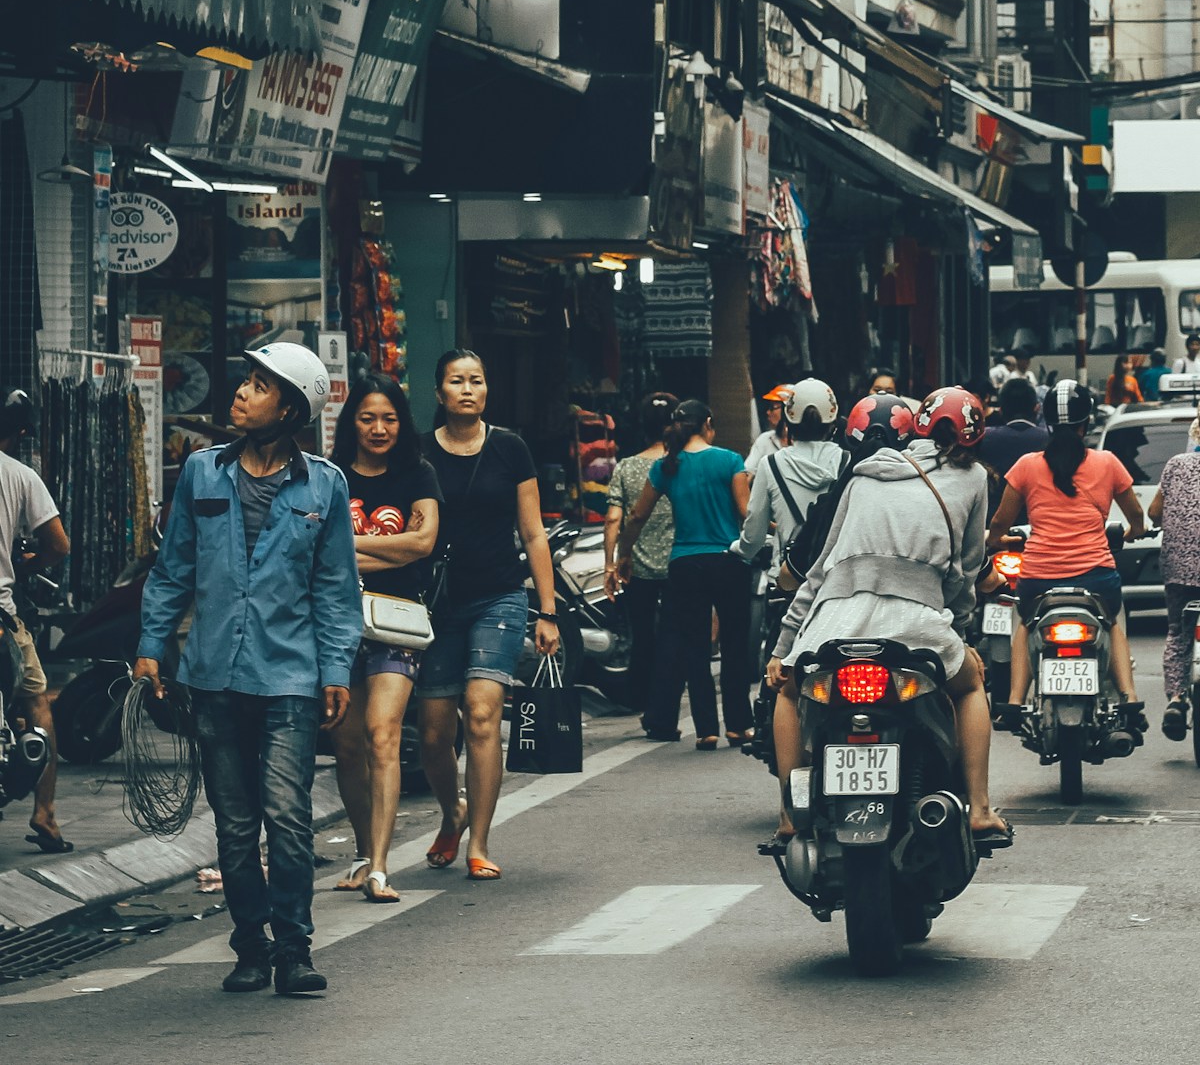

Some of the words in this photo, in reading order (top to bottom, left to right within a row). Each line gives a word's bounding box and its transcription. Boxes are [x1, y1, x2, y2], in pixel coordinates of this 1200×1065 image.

[306, 60, 344, 117] BEST
[120, 195, 143, 206] SUN
[145, 198, 175, 226] TOURS
[238, 202, 303, 219] Island
[116, 247, 139, 263] 7A
[108, 262, 122, 271] inh
[125, 261, 142, 272] Liet
[1051, 662, 1089, 676] 29-E2
[1048, 677, 1093, 692] 107.18
[519, 701, 536, 750] SALE
[835, 748, 888, 769] 30-H7
[836, 771, 888, 791] 1855
[867, 802, 884, 814] 68
